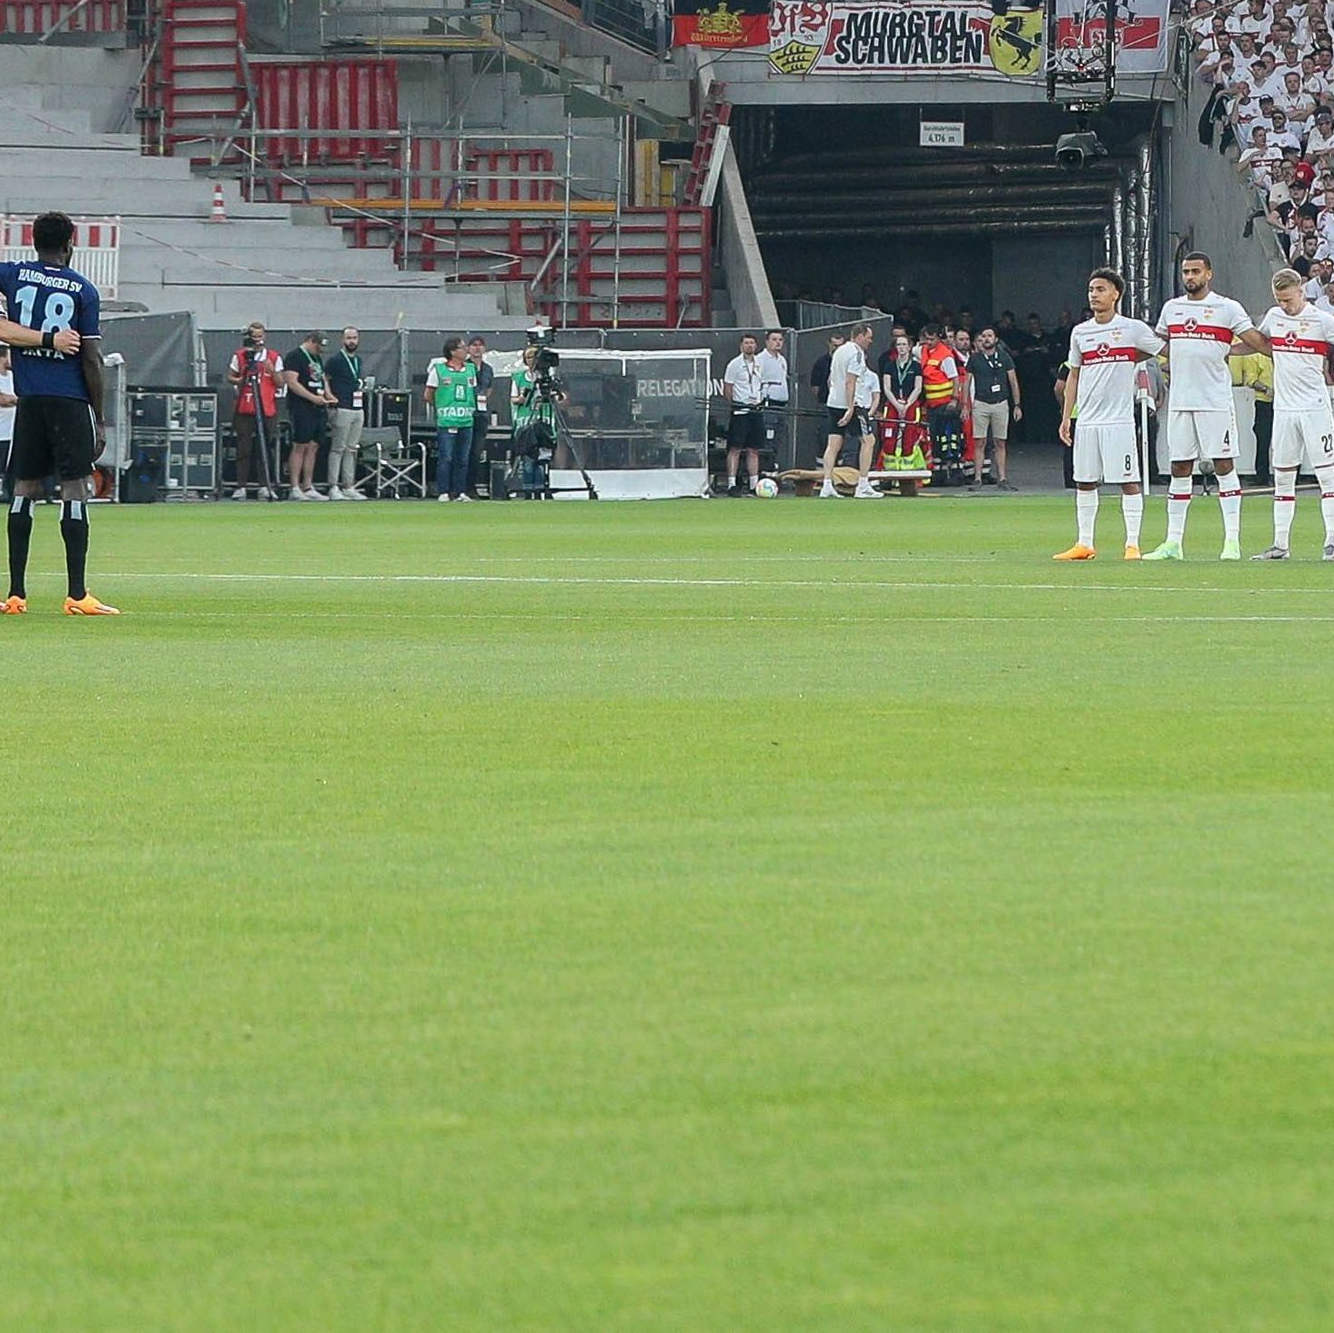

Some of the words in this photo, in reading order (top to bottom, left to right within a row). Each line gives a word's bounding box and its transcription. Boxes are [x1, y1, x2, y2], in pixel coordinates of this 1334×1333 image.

[846, 11, 970, 39] MURGTAL
[835, 34, 983, 64] SCHWABEN
[18, 269, 69, 291] HAMBURGER
[69, 281, 82, 293] SV
[15, 285, 75, 335] 18
[1223, 429, 1230, 446] 4
[1321, 433, 1334, 453] 22
[1124, 454, 1131, 471] 8
